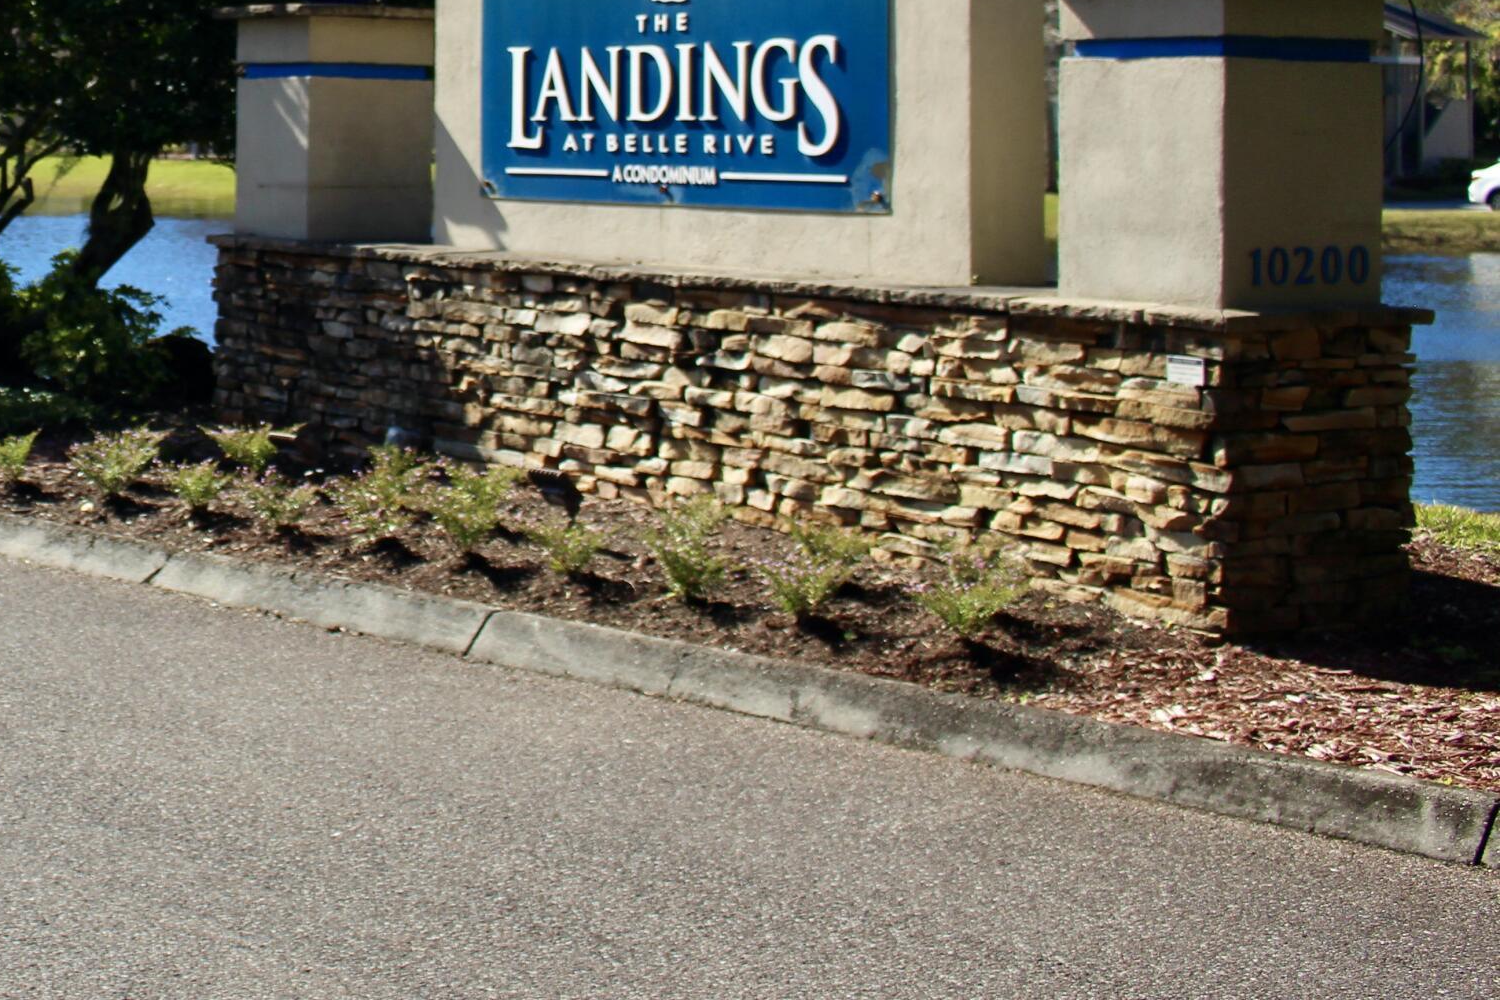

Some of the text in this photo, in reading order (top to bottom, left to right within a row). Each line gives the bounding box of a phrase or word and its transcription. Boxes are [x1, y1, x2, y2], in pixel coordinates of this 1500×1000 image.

[636, 13, 689, 32] THE
[506, 35, 841, 158] LANDINGS
[563, 133, 774, 155] AT BELLE RIVE
[612, 164, 717, 185] A CONDOMINIUM
[1249, 244, 1370, 287] 10200
